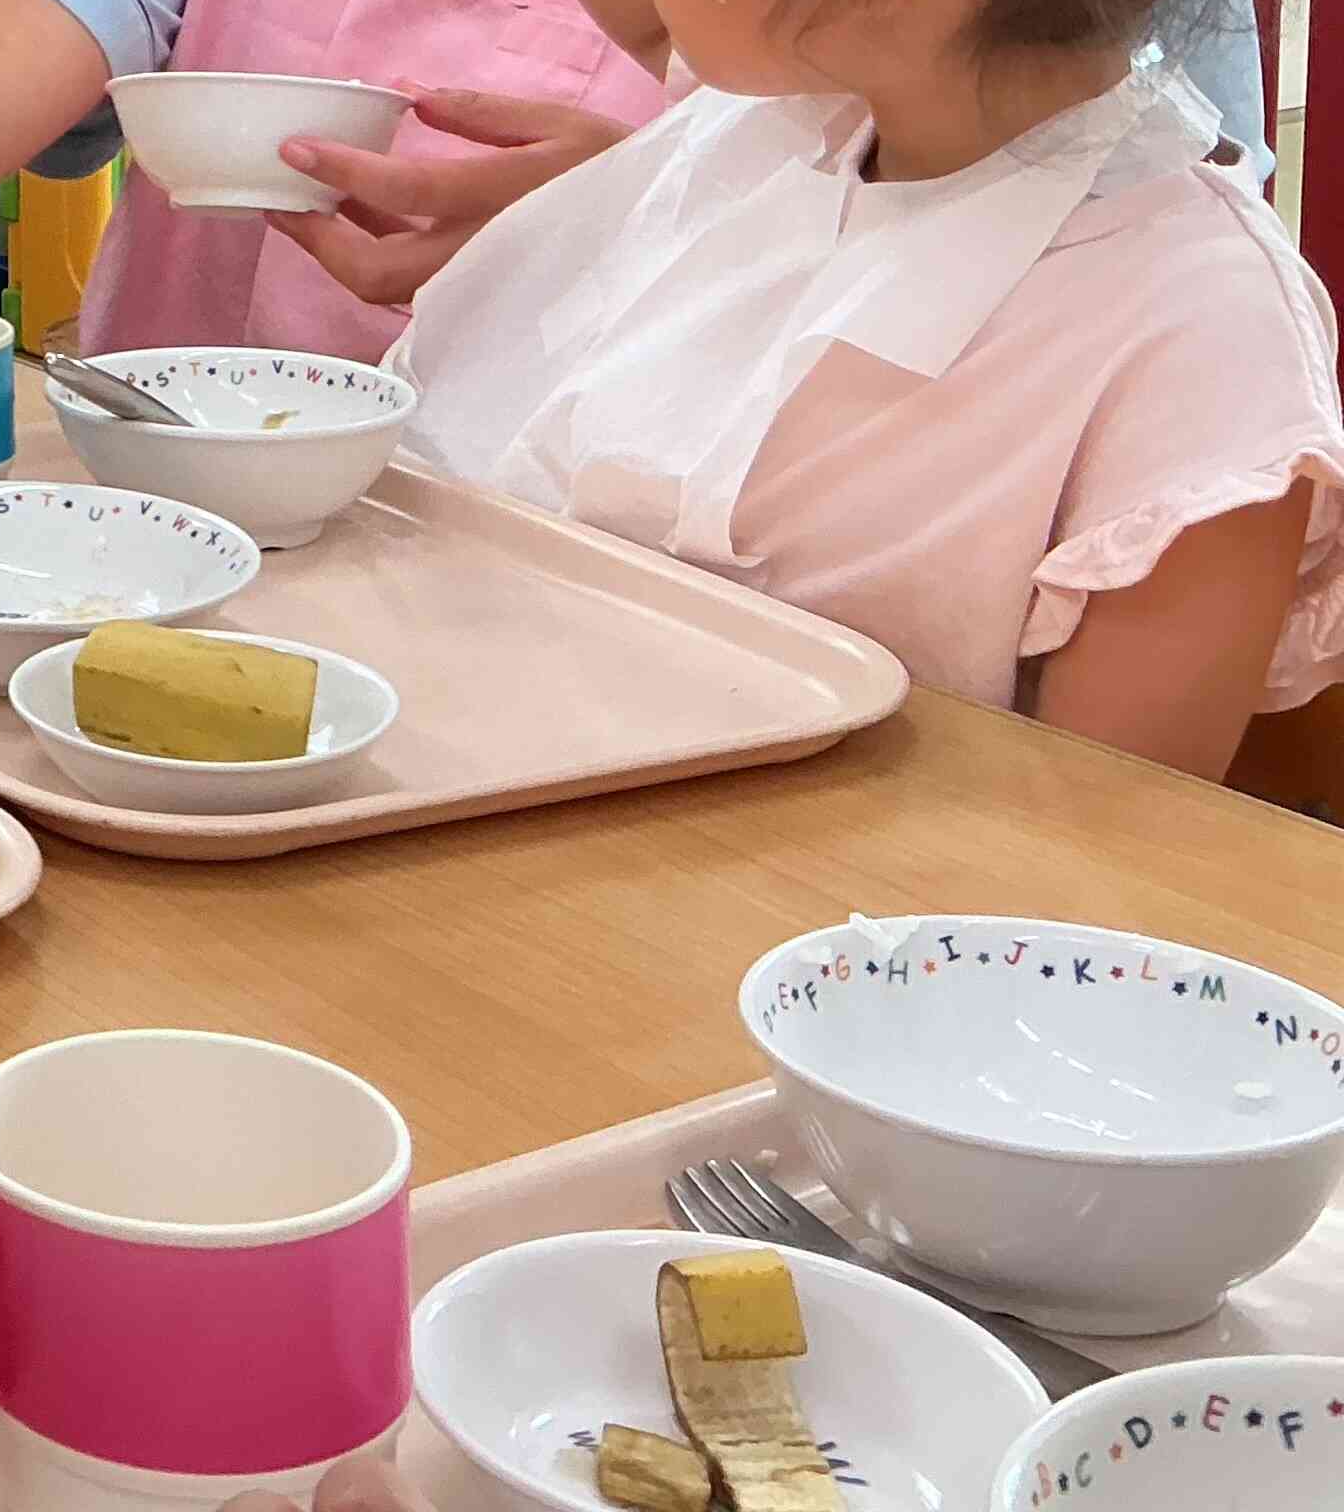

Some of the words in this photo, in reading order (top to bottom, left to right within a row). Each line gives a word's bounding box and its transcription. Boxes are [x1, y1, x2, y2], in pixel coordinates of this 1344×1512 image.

[887, 958, 909, 985] H
[938, 935, 962, 962] I
[1004, 940, 1029, 965] J
[1073, 958, 1097, 984] K
[1141, 954, 1158, 981] L
[1199, 975, 1227, 1002] M
[1275, 1015, 1298, 1046] N
[1123, 1416, 1154, 1449] D
[1202, 1394, 1231, 1433] E
[1278, 1410, 1303, 1451] F
